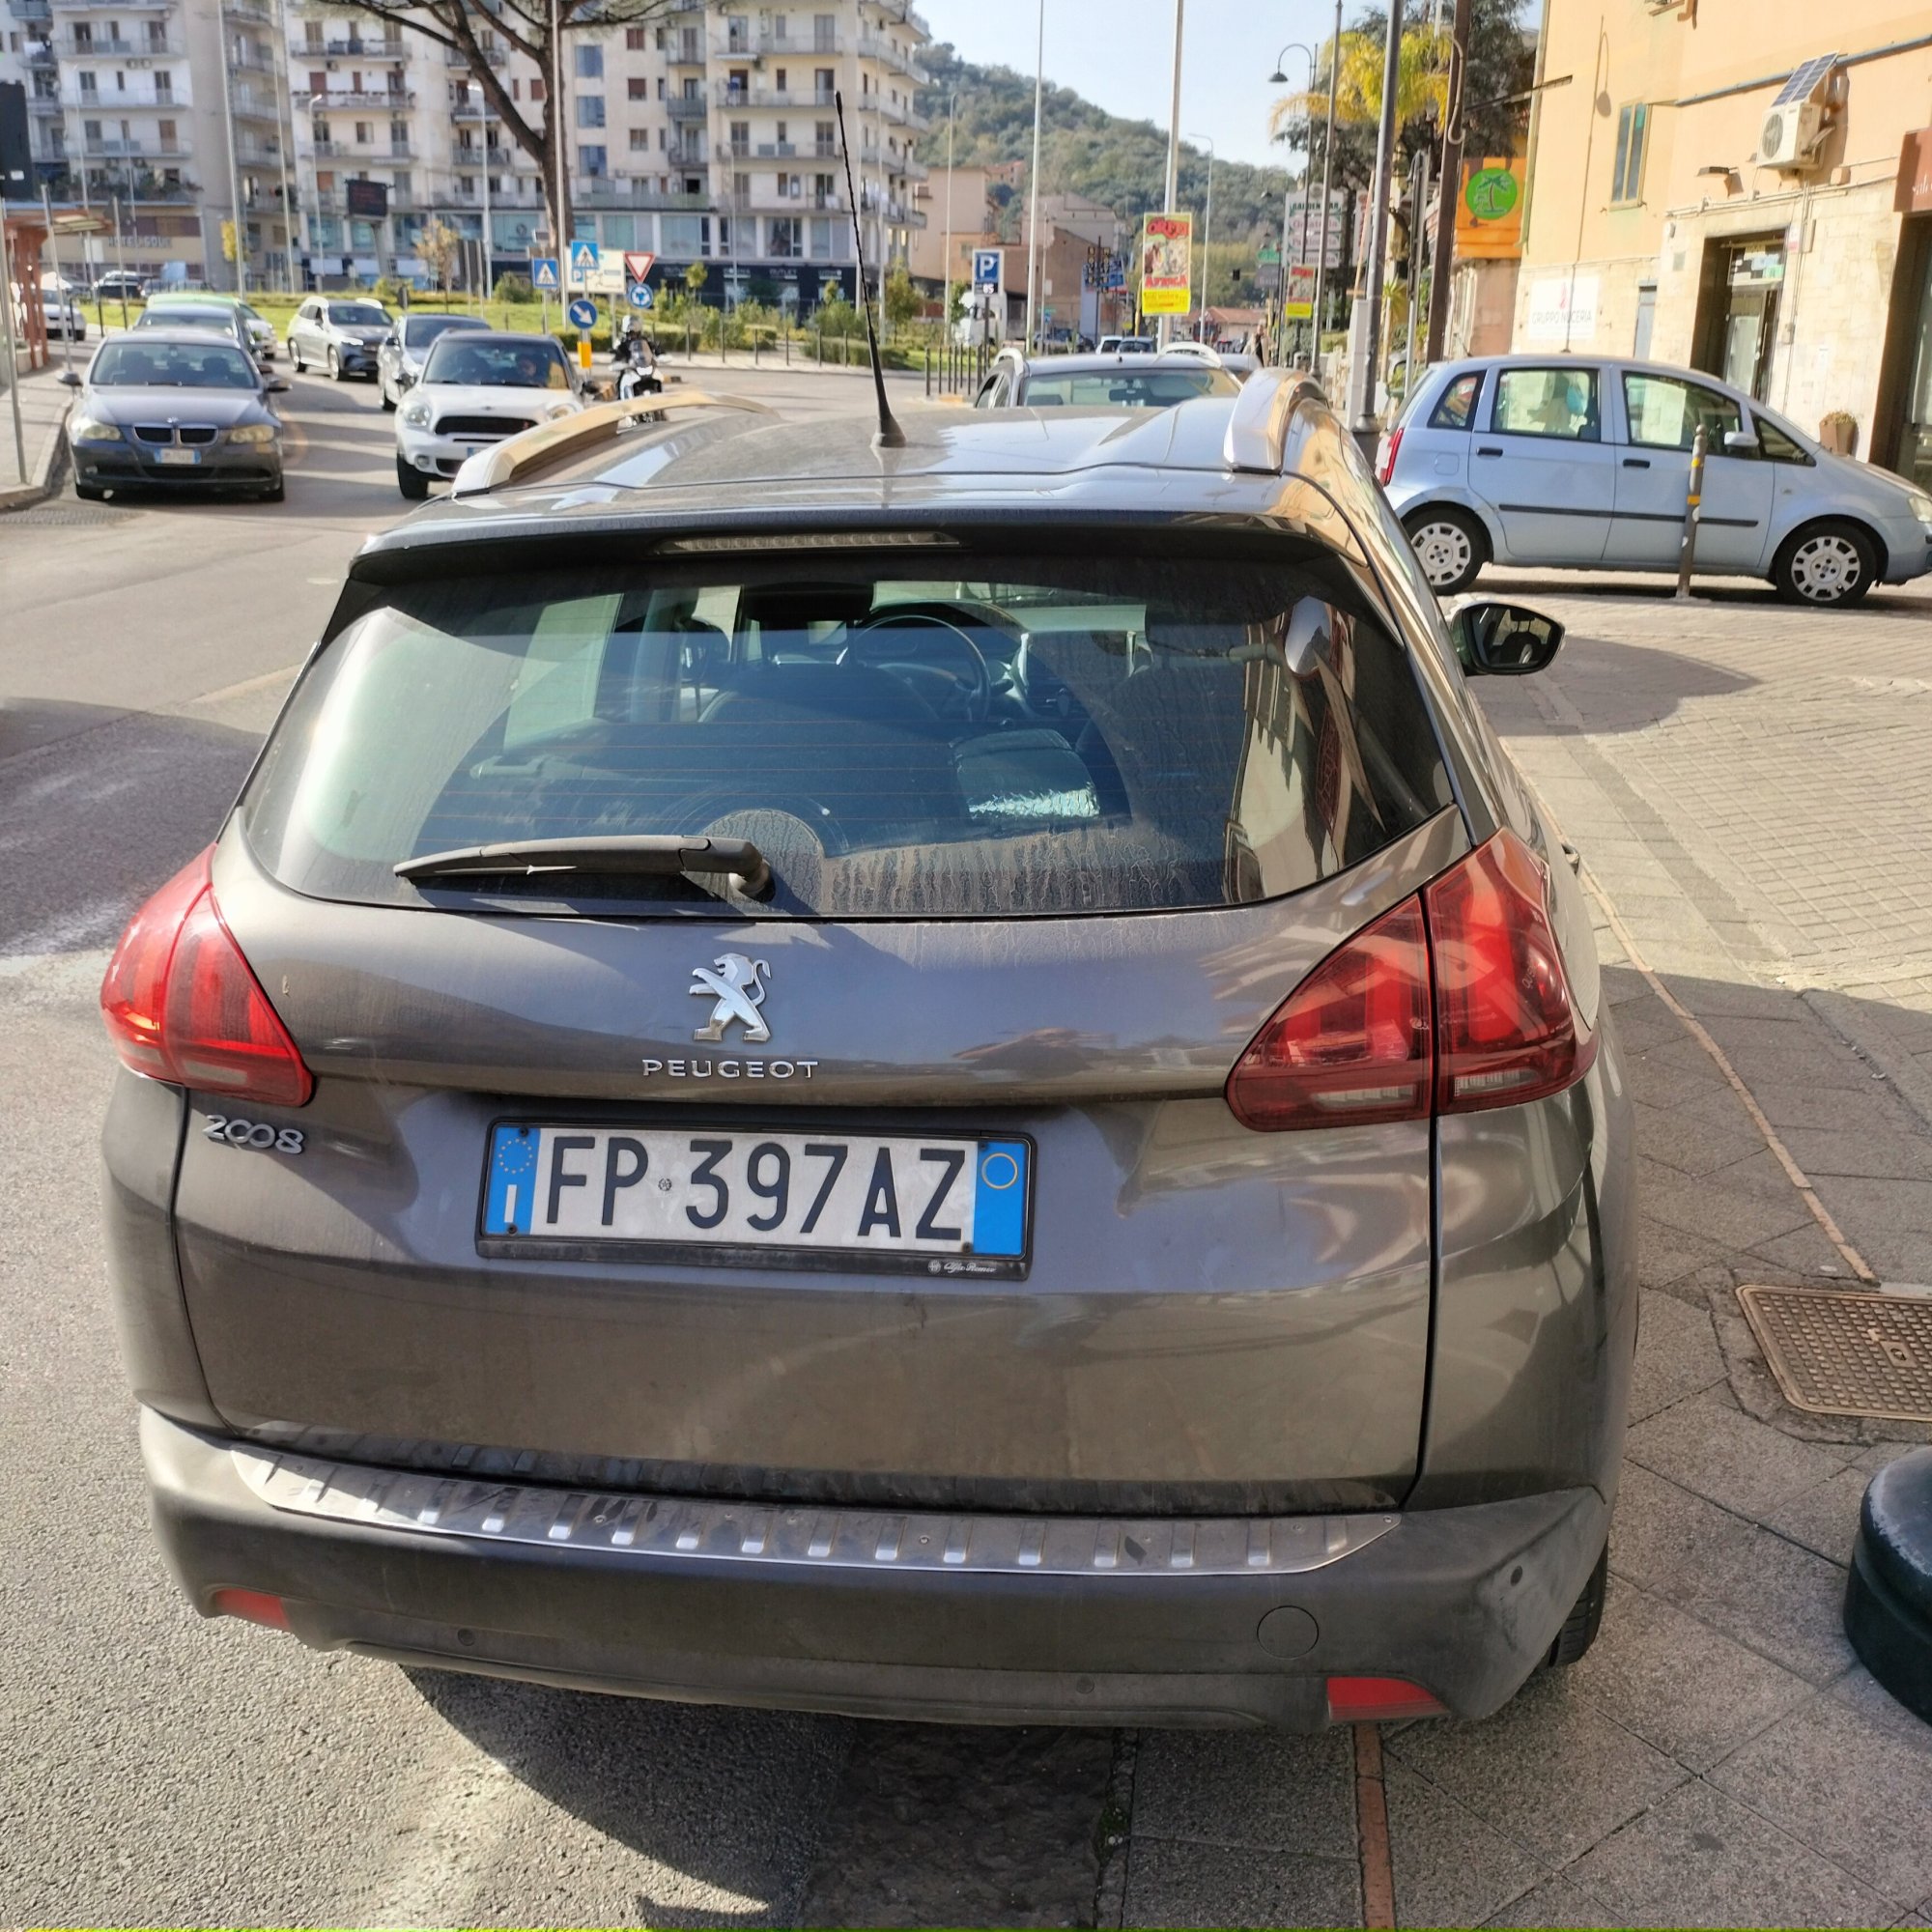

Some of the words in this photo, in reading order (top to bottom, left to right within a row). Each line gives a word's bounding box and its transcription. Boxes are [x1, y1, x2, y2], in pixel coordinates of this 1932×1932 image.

[980, 254, 996, 277] P
[1532, 311, 1559, 325] GRUPPO
[641, 1059, 818, 1078] PEUGEOT
[202, 1114, 304, 1154] 2008
[944, 1261, 965, 1274] Alfa
[966, 1262, 997, 1273] Romeo
